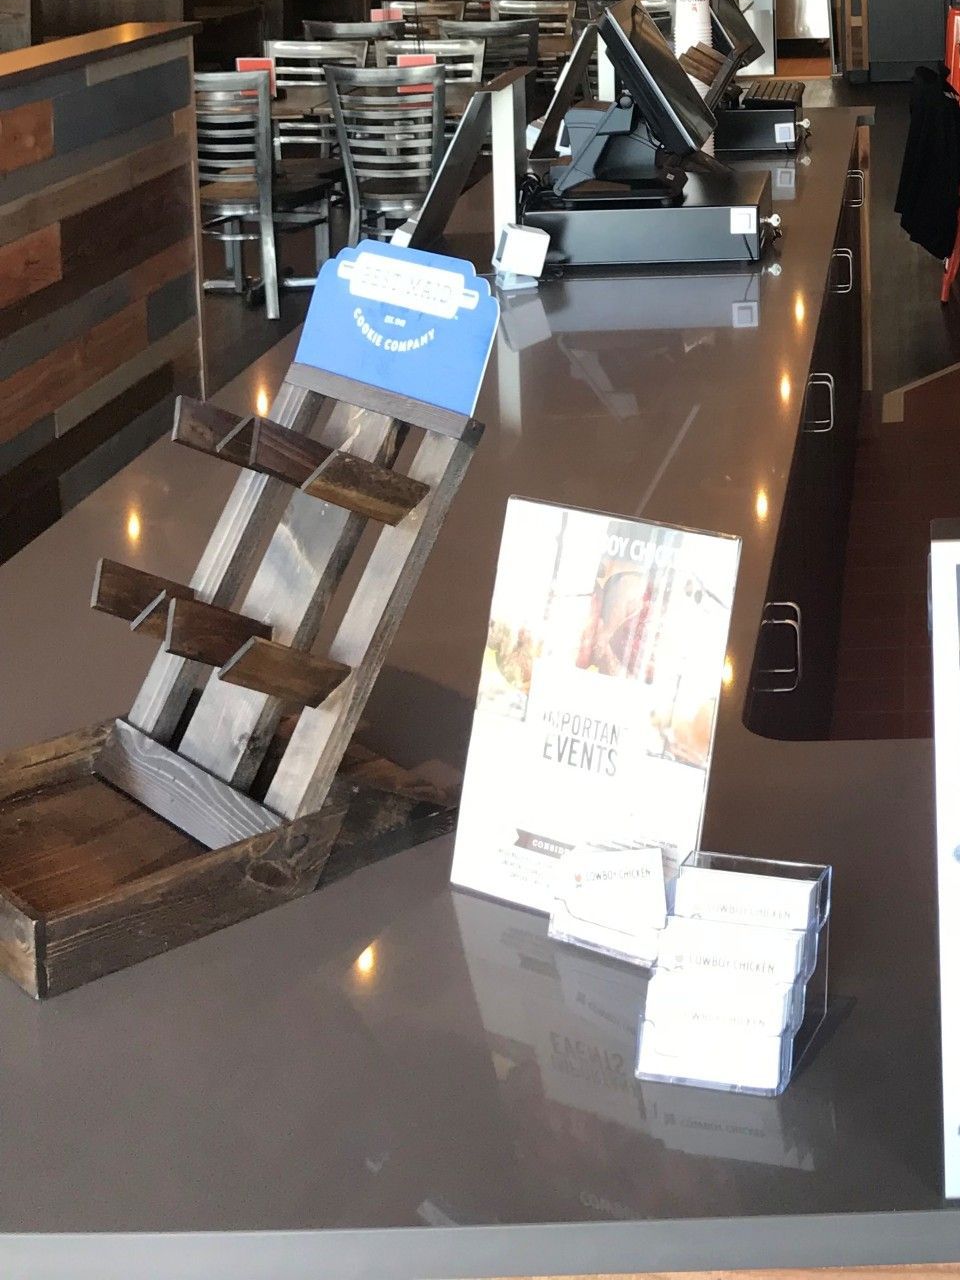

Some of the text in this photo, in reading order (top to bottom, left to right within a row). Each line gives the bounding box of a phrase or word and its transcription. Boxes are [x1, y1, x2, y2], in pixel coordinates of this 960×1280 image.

[353, 307, 383, 347] COOKIE
[384, 328, 436, 352] COMPANY
[542, 734, 618, 777] EVENTS
